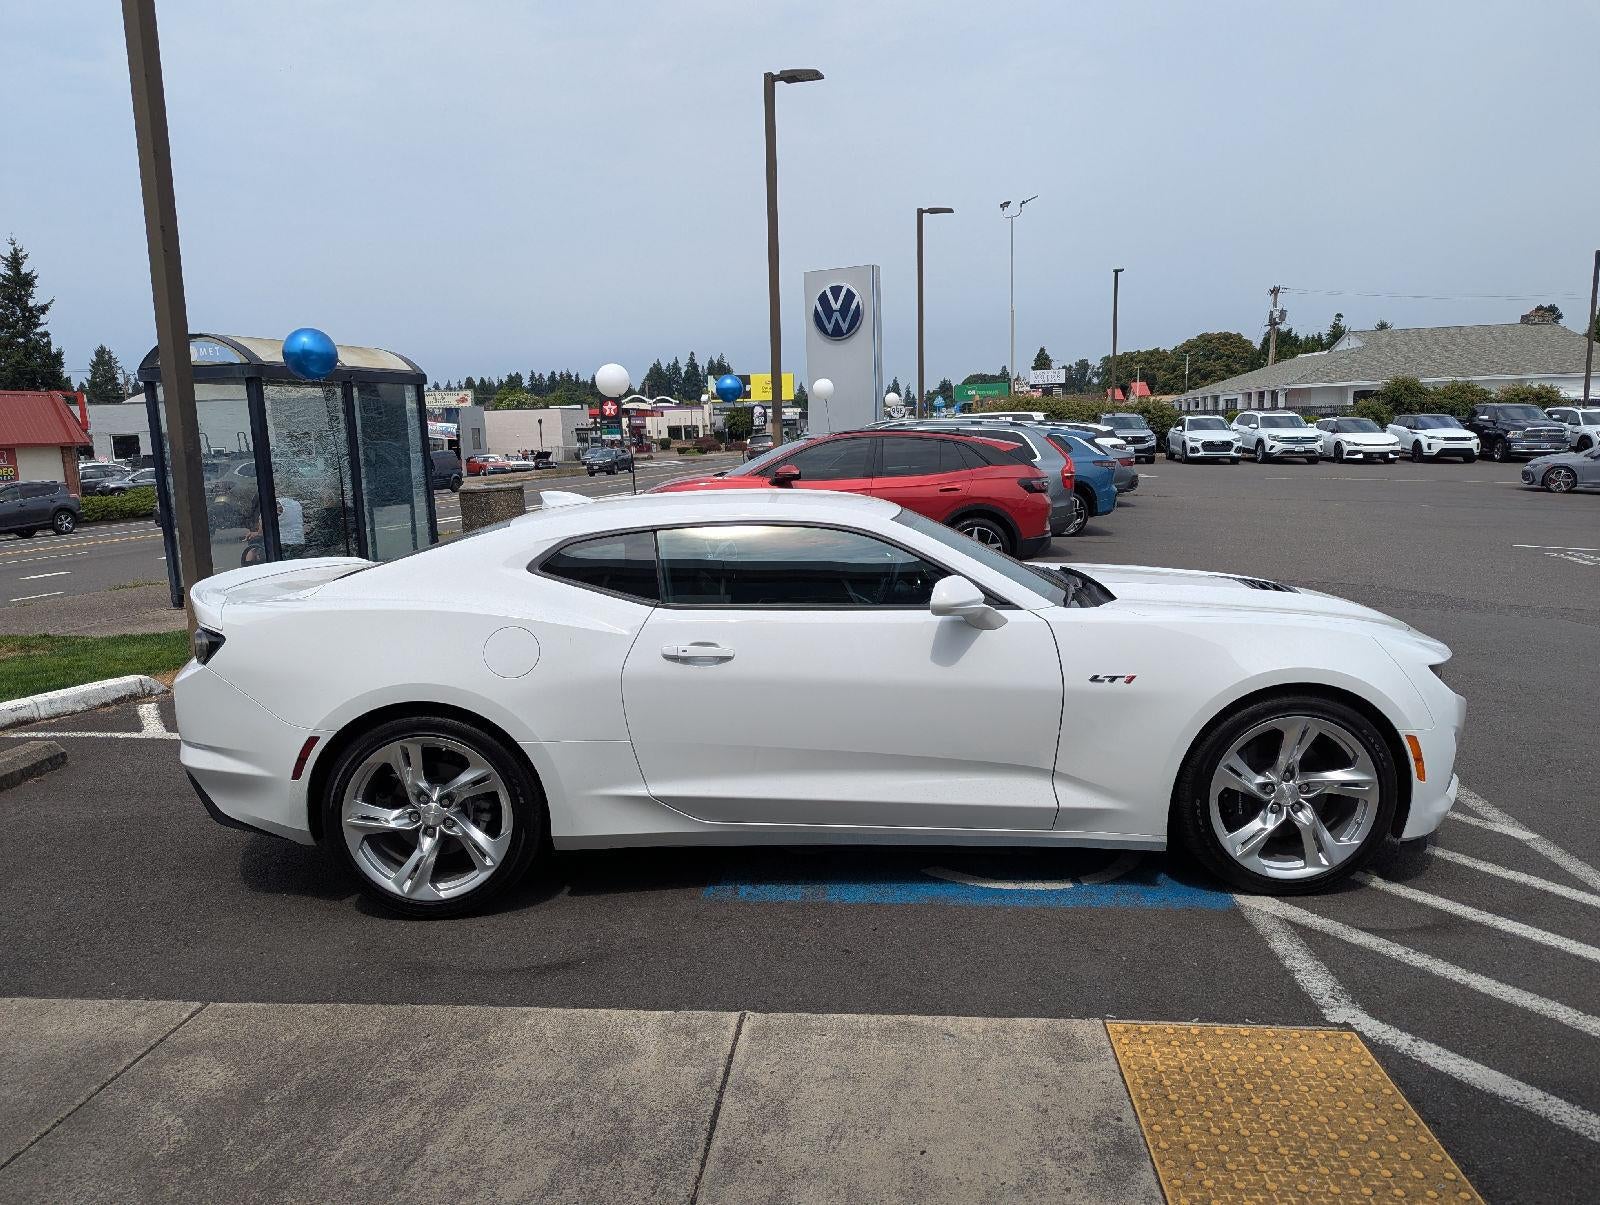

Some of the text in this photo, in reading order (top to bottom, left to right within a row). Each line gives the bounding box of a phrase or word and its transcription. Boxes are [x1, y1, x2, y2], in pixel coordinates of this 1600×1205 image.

[814, 282, 863, 338] VW
[200, 346, 220, 356] MET
[1088, 674, 1137, 684] LT1
